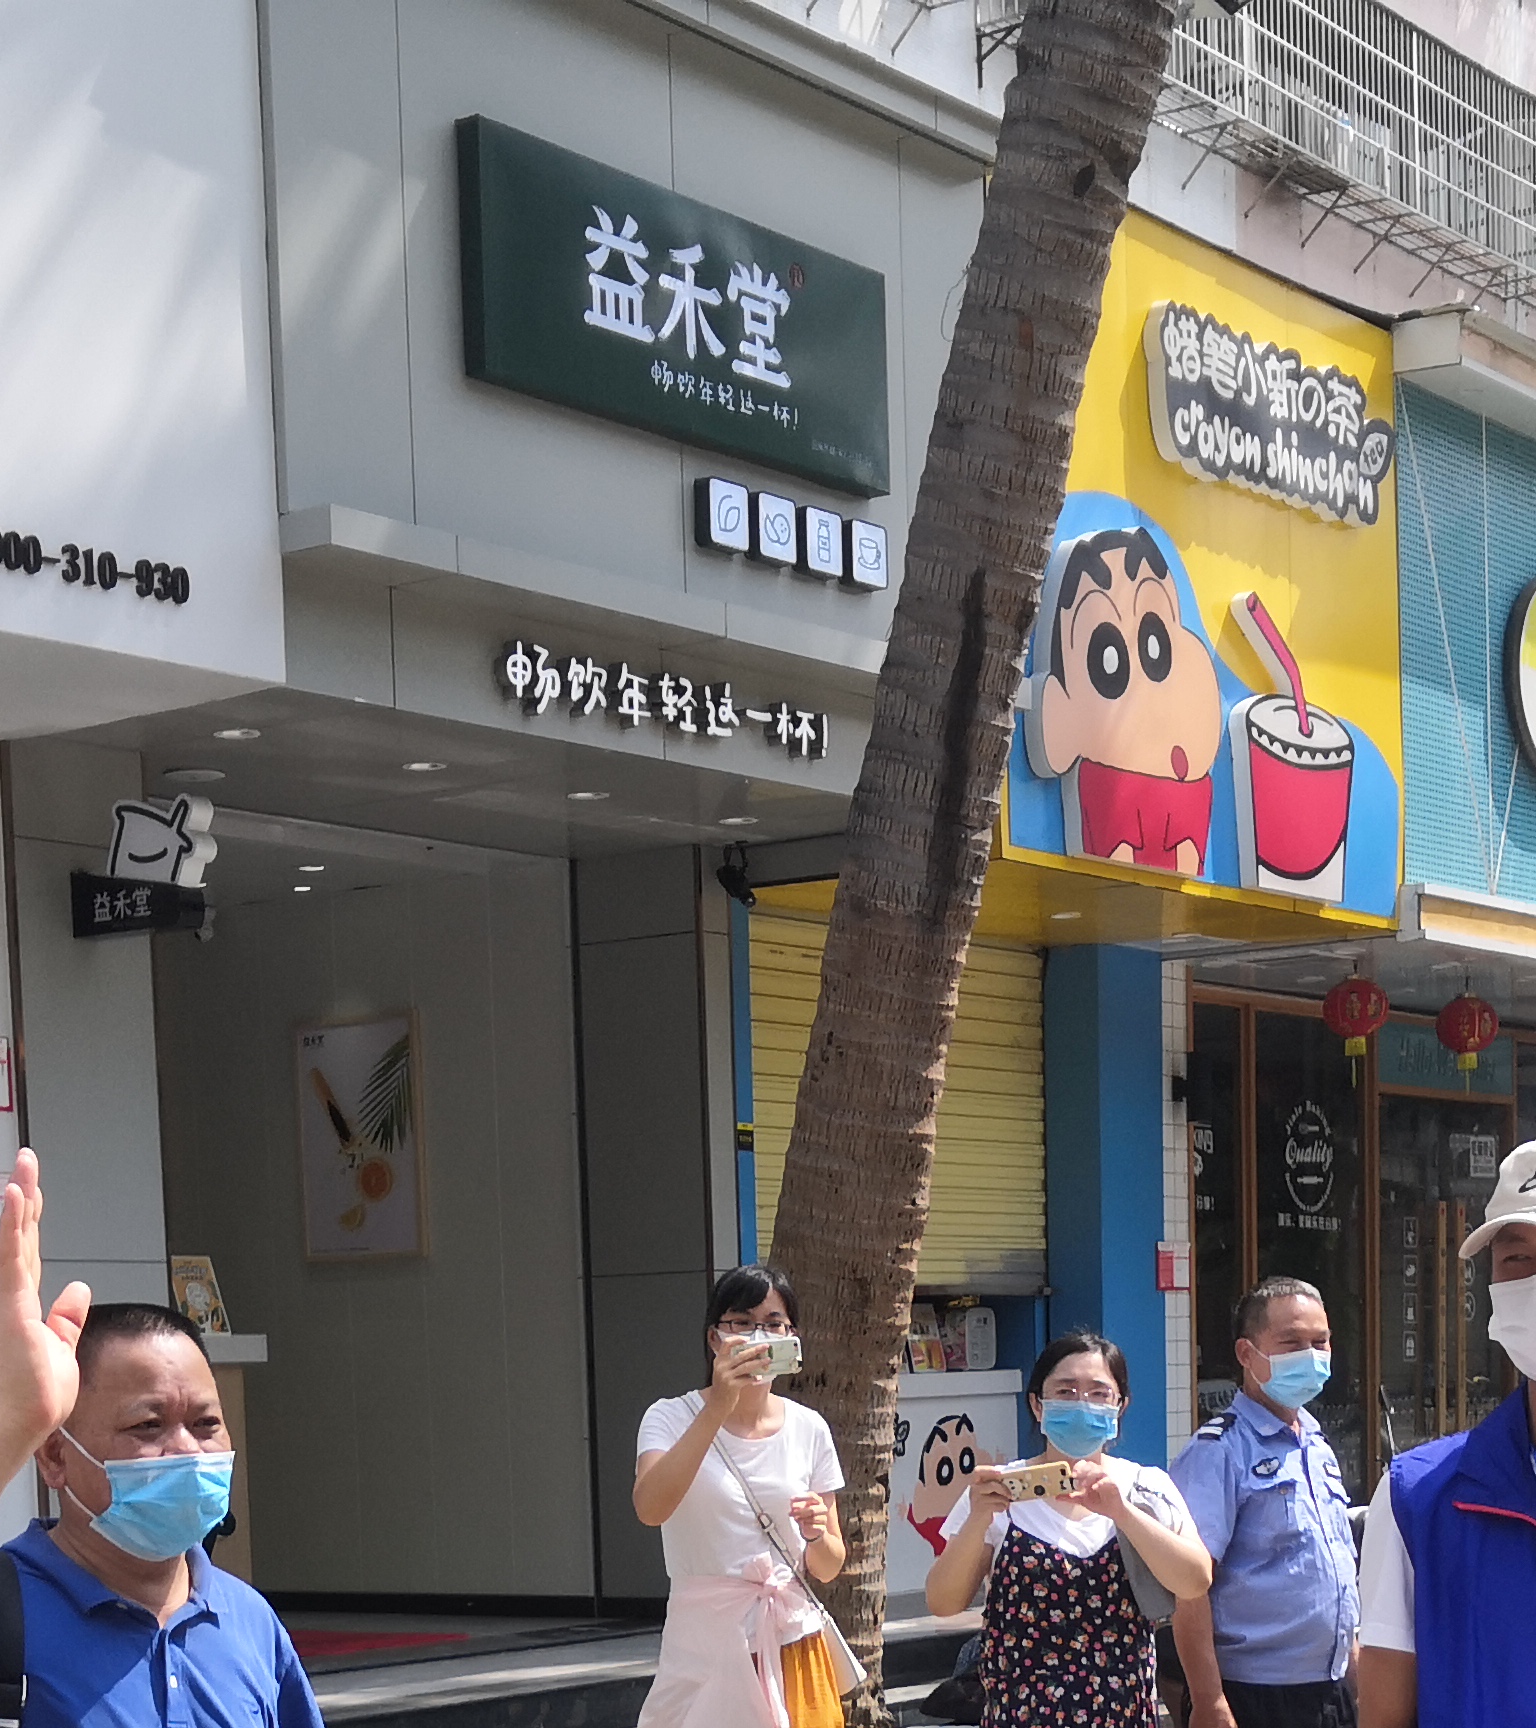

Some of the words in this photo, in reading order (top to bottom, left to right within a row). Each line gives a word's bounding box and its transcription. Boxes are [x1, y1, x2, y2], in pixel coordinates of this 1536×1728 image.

[583, 204, 792, 389] 益禾堂
[650, 359, 800, 431] 畅饮年轻这一杯!
[1163, 309, 1360, 448] 蜡笔小新の茶
[1174, 400, 1262, 475] crayon
[1266, 426, 1374, 516] shinchan
[506, 640, 829, 759] 畅饮年轻这一杯!
[93, 887, 152, 923] 益禾堂
[1284, 1136, 1334, 1173] Quality
